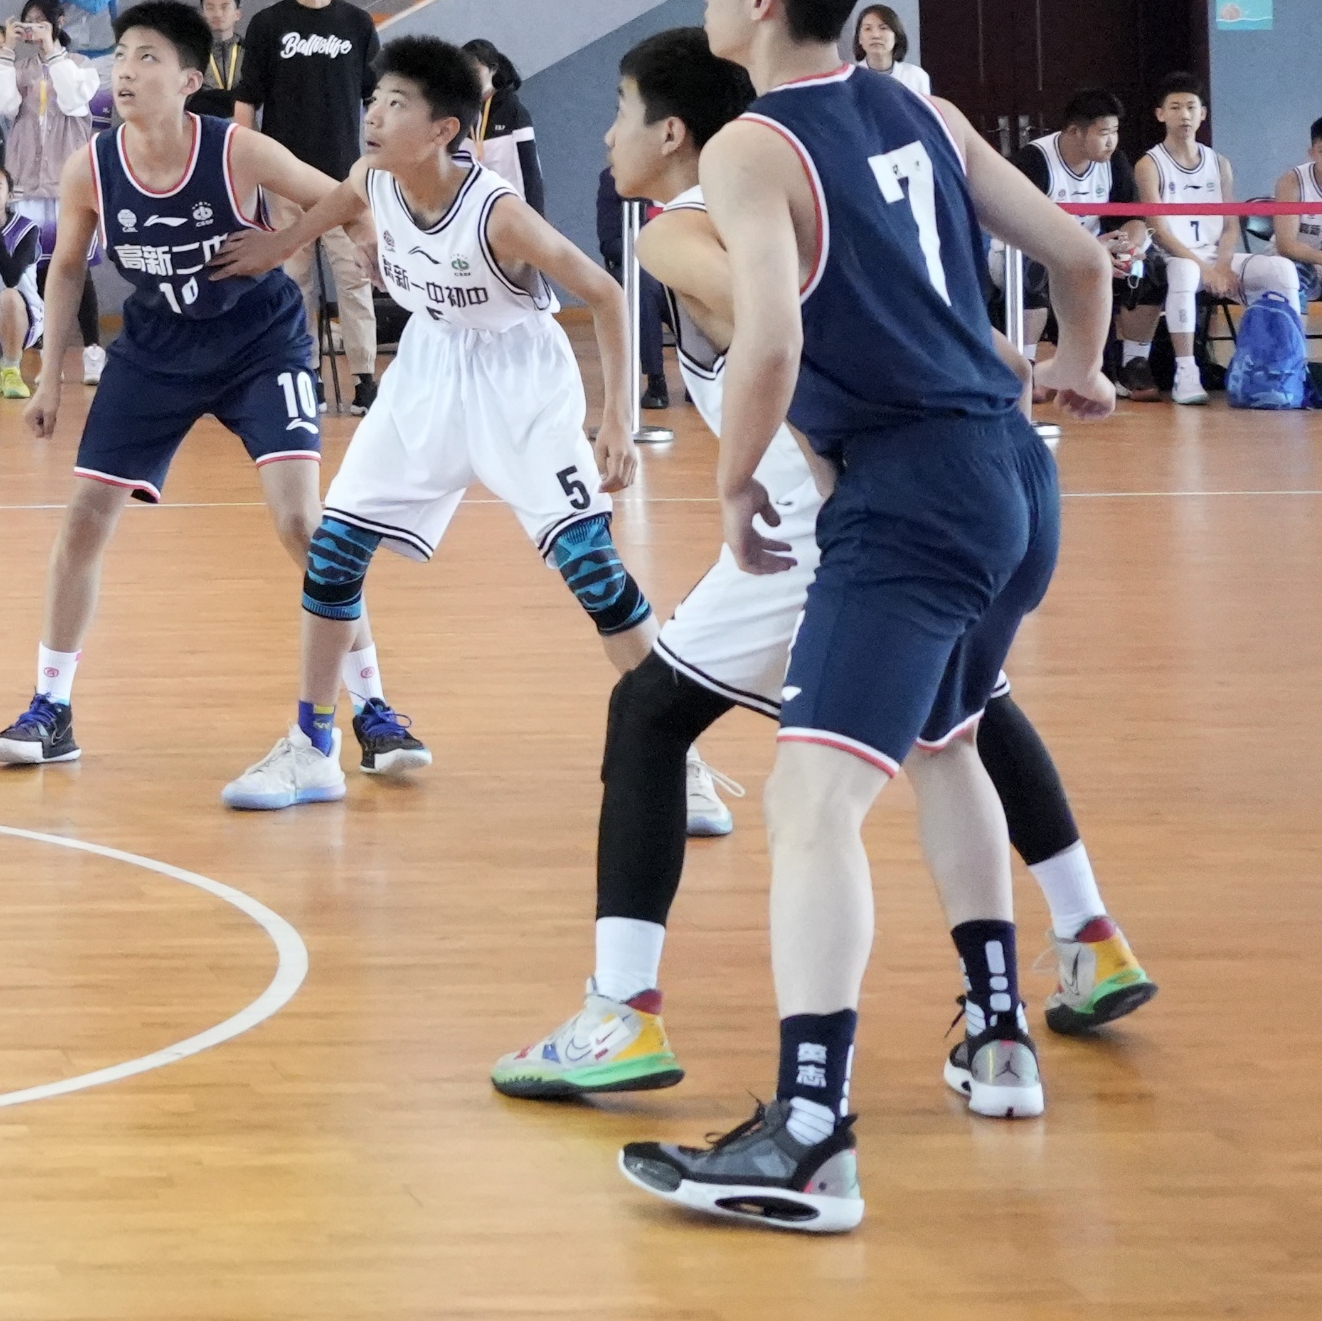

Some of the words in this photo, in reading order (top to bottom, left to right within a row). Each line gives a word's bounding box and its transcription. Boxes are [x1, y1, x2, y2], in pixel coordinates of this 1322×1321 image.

[867, 140, 953, 308] 7
[1190, 220, 1200, 242] 7
[277, 371, 317, 418] 10
[556, 464, 591, 510] 5
